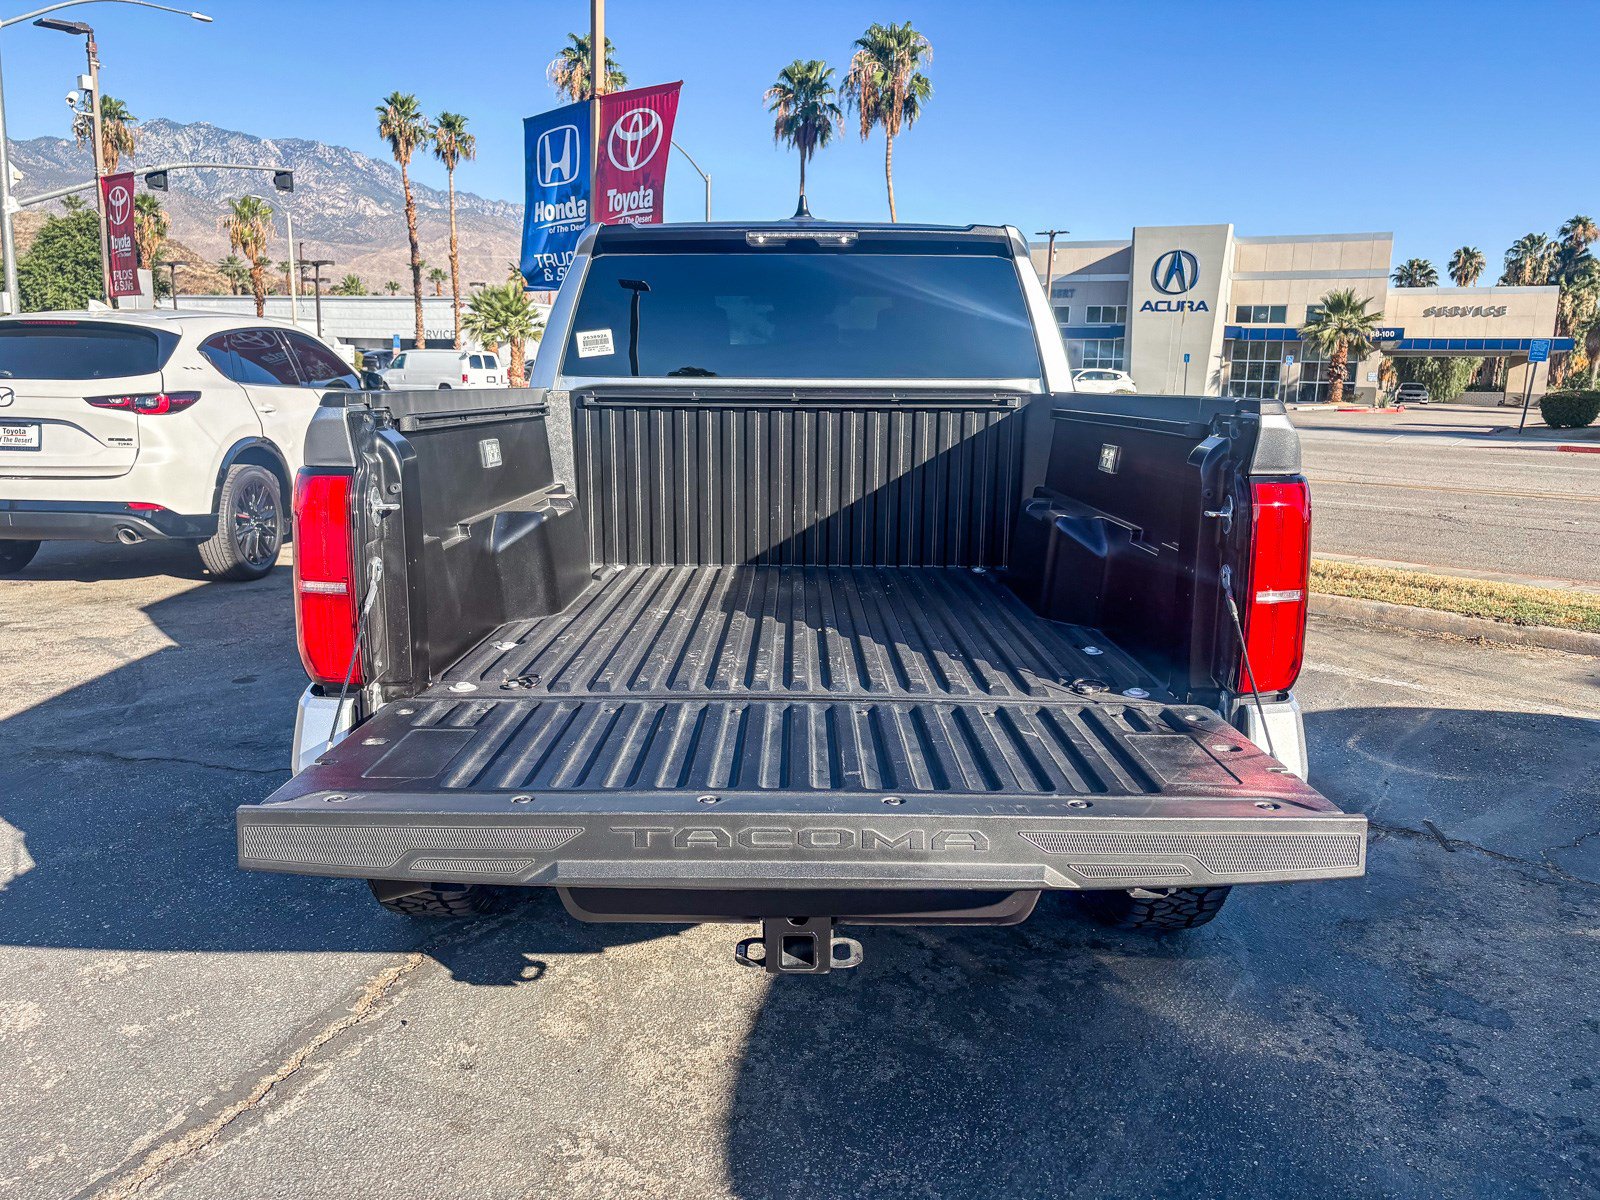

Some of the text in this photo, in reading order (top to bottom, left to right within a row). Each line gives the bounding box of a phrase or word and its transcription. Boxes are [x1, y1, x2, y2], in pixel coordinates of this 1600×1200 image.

[607, 185, 653, 214] Toyota
[534, 196, 587, 223] Honda
[625, 216, 634, 224] The
[635, 215, 652, 225] Desert
[549, 226, 556, 234] of
[557, 225, 569, 233] The
[534, 251, 574, 268] TRUC
[544, 268, 553, 281] &
[1140, 301, 1209, 312] ACURA
[1424, 305, 1507, 317] SERVICE
[414, 329, 455, 339] RVICE
[3, 427, 27, 436] Toyota
[610, 826, 990, 850] TACOMA
